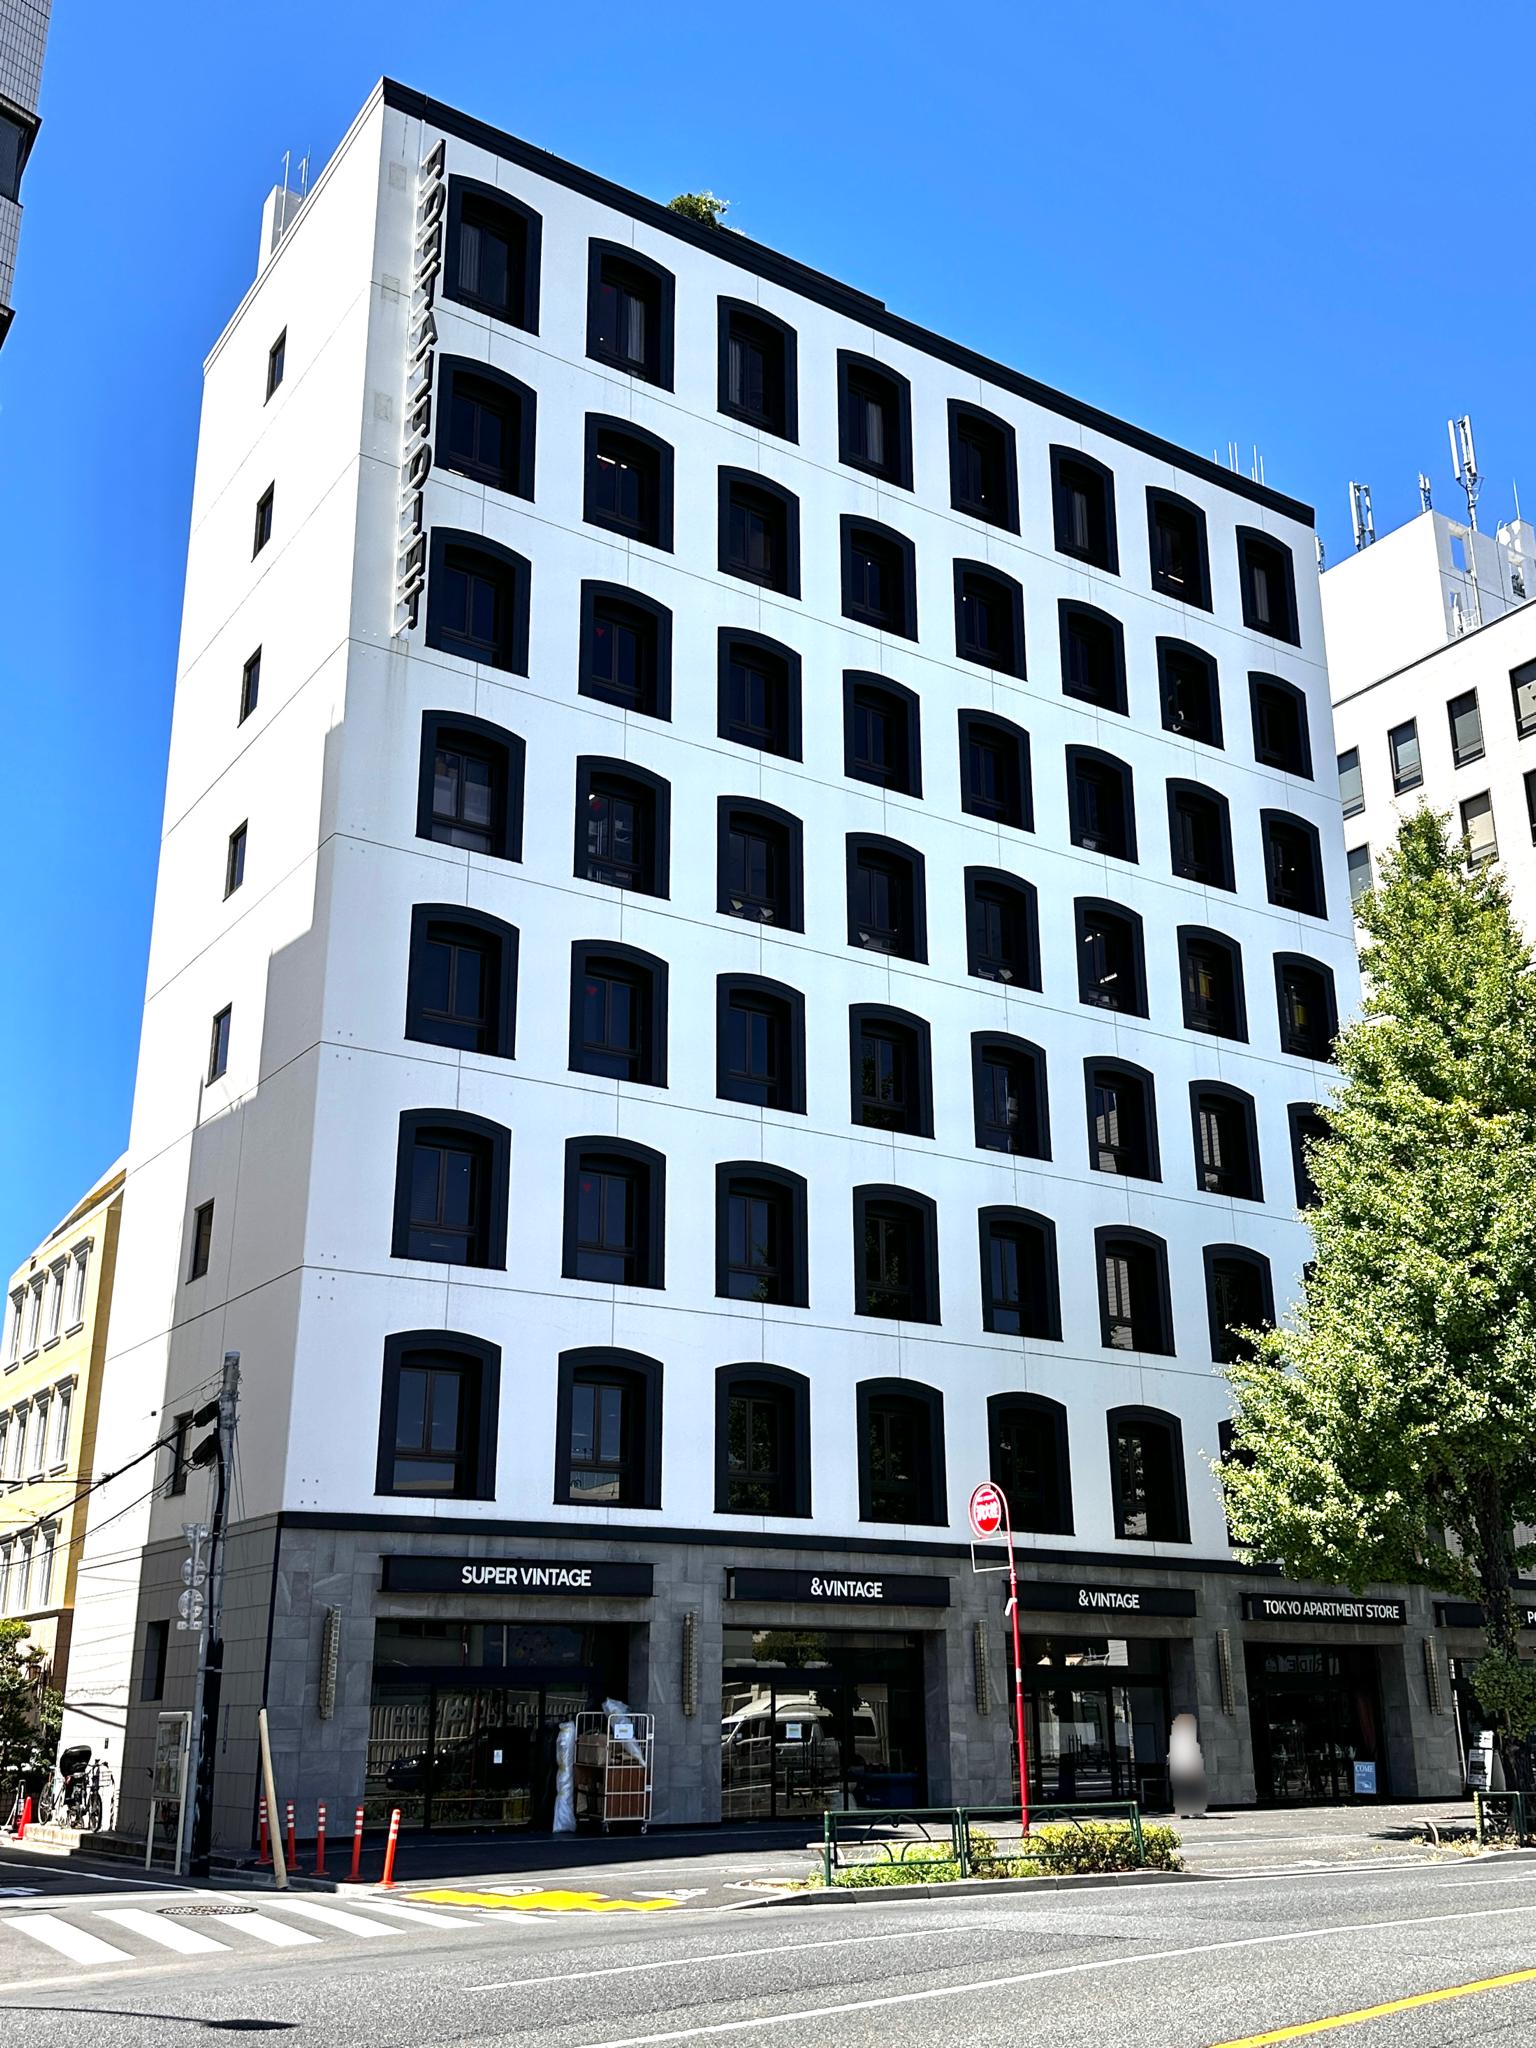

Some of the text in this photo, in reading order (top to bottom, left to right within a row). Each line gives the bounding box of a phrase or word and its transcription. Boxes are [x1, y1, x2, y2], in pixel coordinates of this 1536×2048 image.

[461, 1565, 592, 1587] SUPER VINTAGE
[1263, 1599, 1400, 1619] TOKYO APARTMENT STORE
